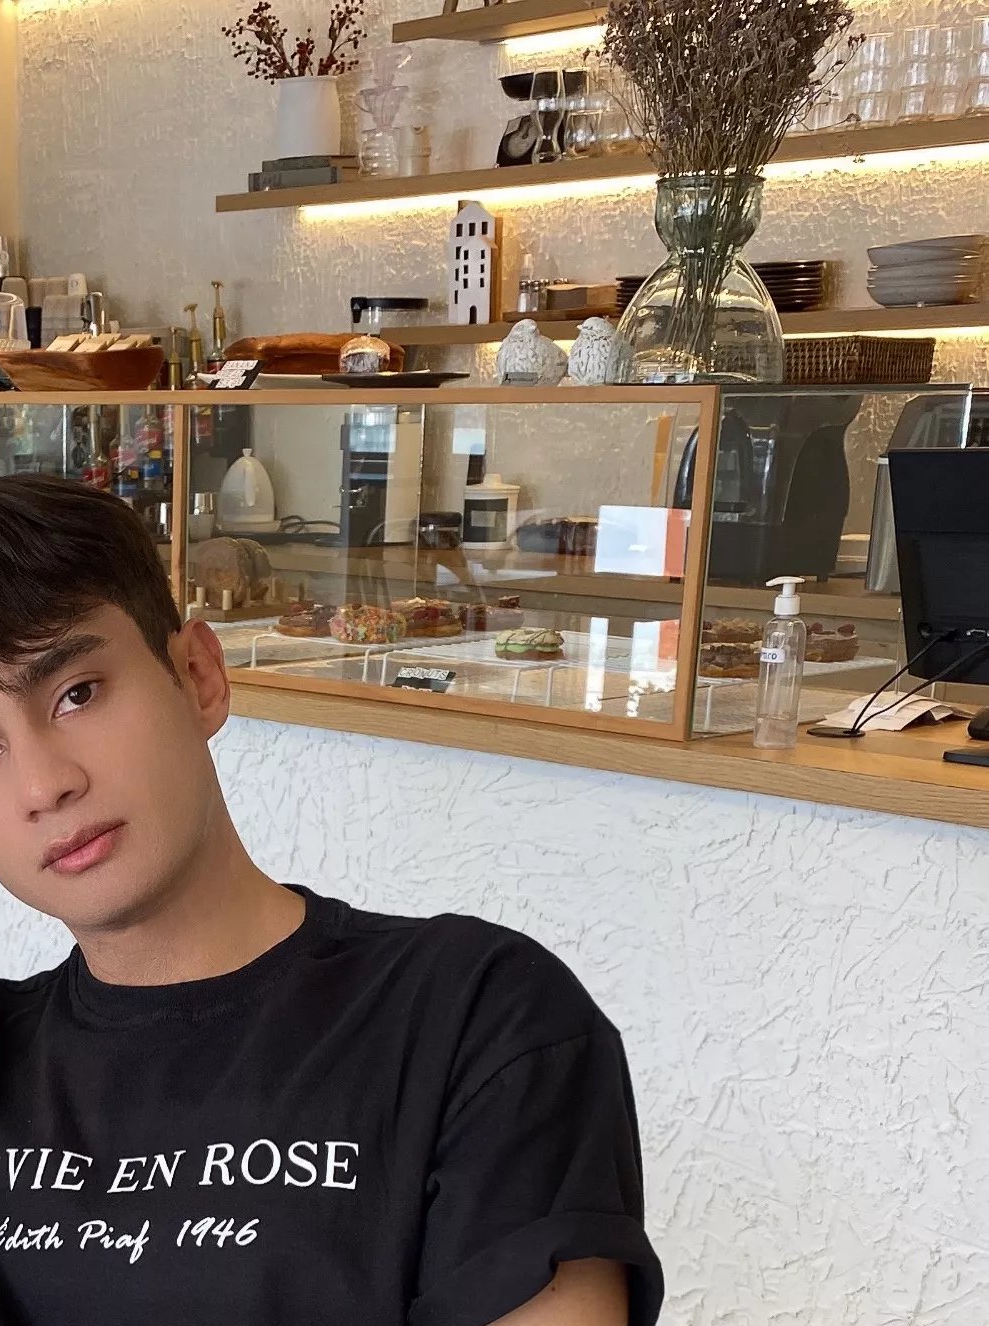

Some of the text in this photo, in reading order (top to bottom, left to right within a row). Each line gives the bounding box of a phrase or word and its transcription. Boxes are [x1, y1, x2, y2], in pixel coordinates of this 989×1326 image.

[6, 1148, 93, 1192] VIE
[107, 1150, 187, 1194] EN
[198, 1138, 360, 1190] ROSE
[77, 1219, 151, 1264] Piaf
[176, 1217, 261, 1248] 1946
